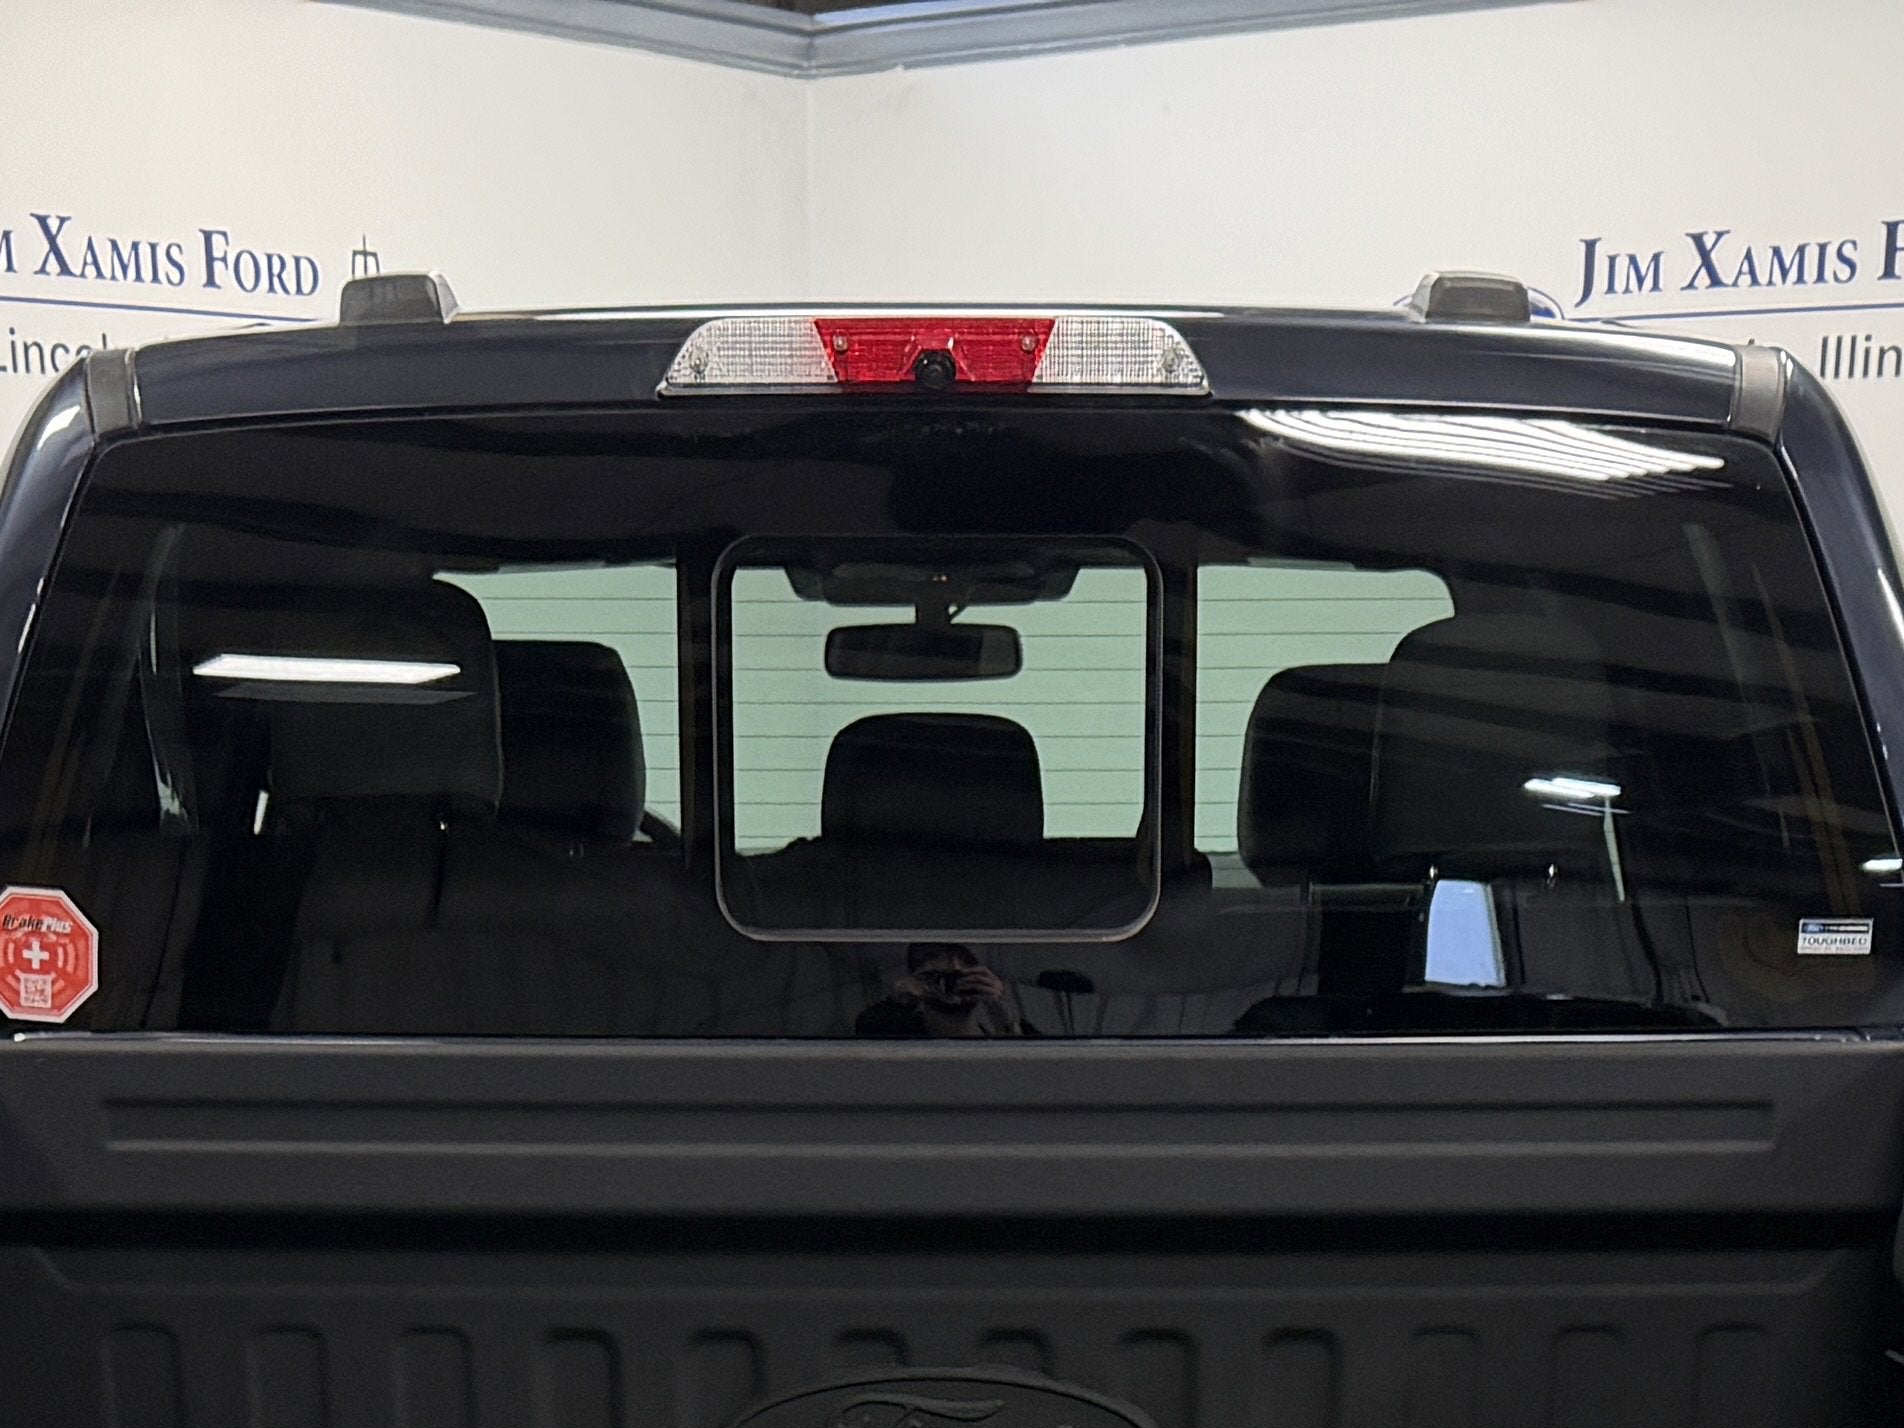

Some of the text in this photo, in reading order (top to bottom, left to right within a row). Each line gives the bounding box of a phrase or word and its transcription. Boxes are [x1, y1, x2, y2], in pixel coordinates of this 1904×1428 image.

[29, 211, 187, 287] XAMIS
[198, 228, 321, 298] FORD
[1574, 237, 1666, 308] JIM
[1680, 229, 1860, 291] XAMIS
